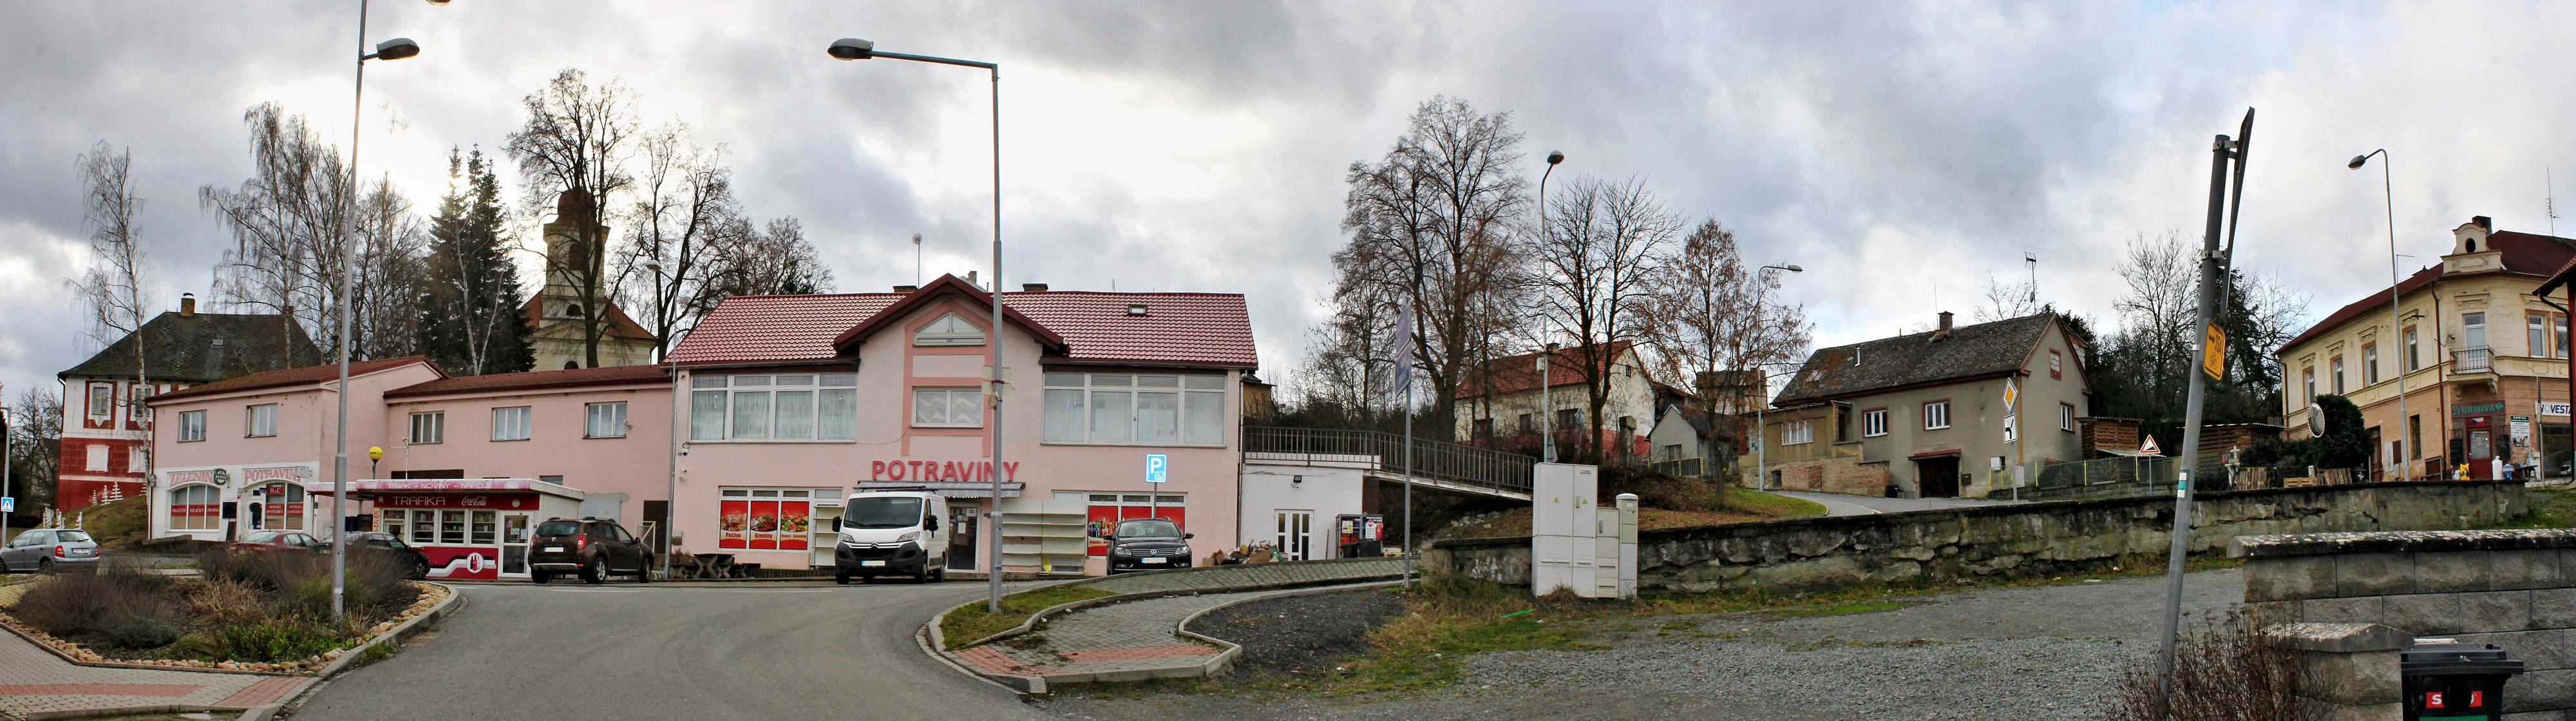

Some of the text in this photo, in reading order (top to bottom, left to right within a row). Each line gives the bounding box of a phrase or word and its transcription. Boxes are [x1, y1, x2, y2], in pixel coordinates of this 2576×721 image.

[2462, 404, 2495, 413] KRMIVA
[2540, 404, 2570, 414] OVEST
[872, 459, 1019, 481] POTRAVINY
[1150, 457, 1162, 474] P
[169, 472, 215, 488] ZELENIN
[393, 496, 446, 506] TRAFIKA
